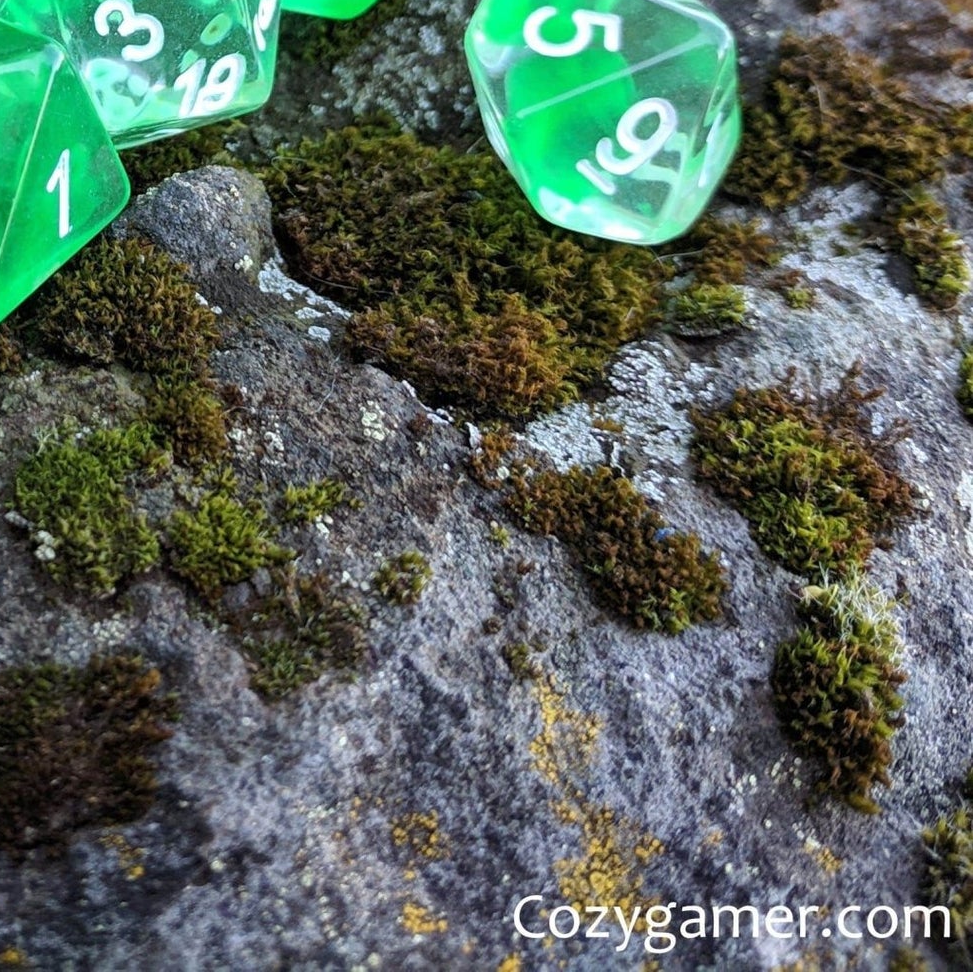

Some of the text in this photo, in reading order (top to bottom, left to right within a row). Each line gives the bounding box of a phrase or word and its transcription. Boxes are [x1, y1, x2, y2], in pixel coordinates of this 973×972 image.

[523, 5, 623, 58] 5
[576, 97, 678, 196] 9
[46, 148, 73, 239] 1
